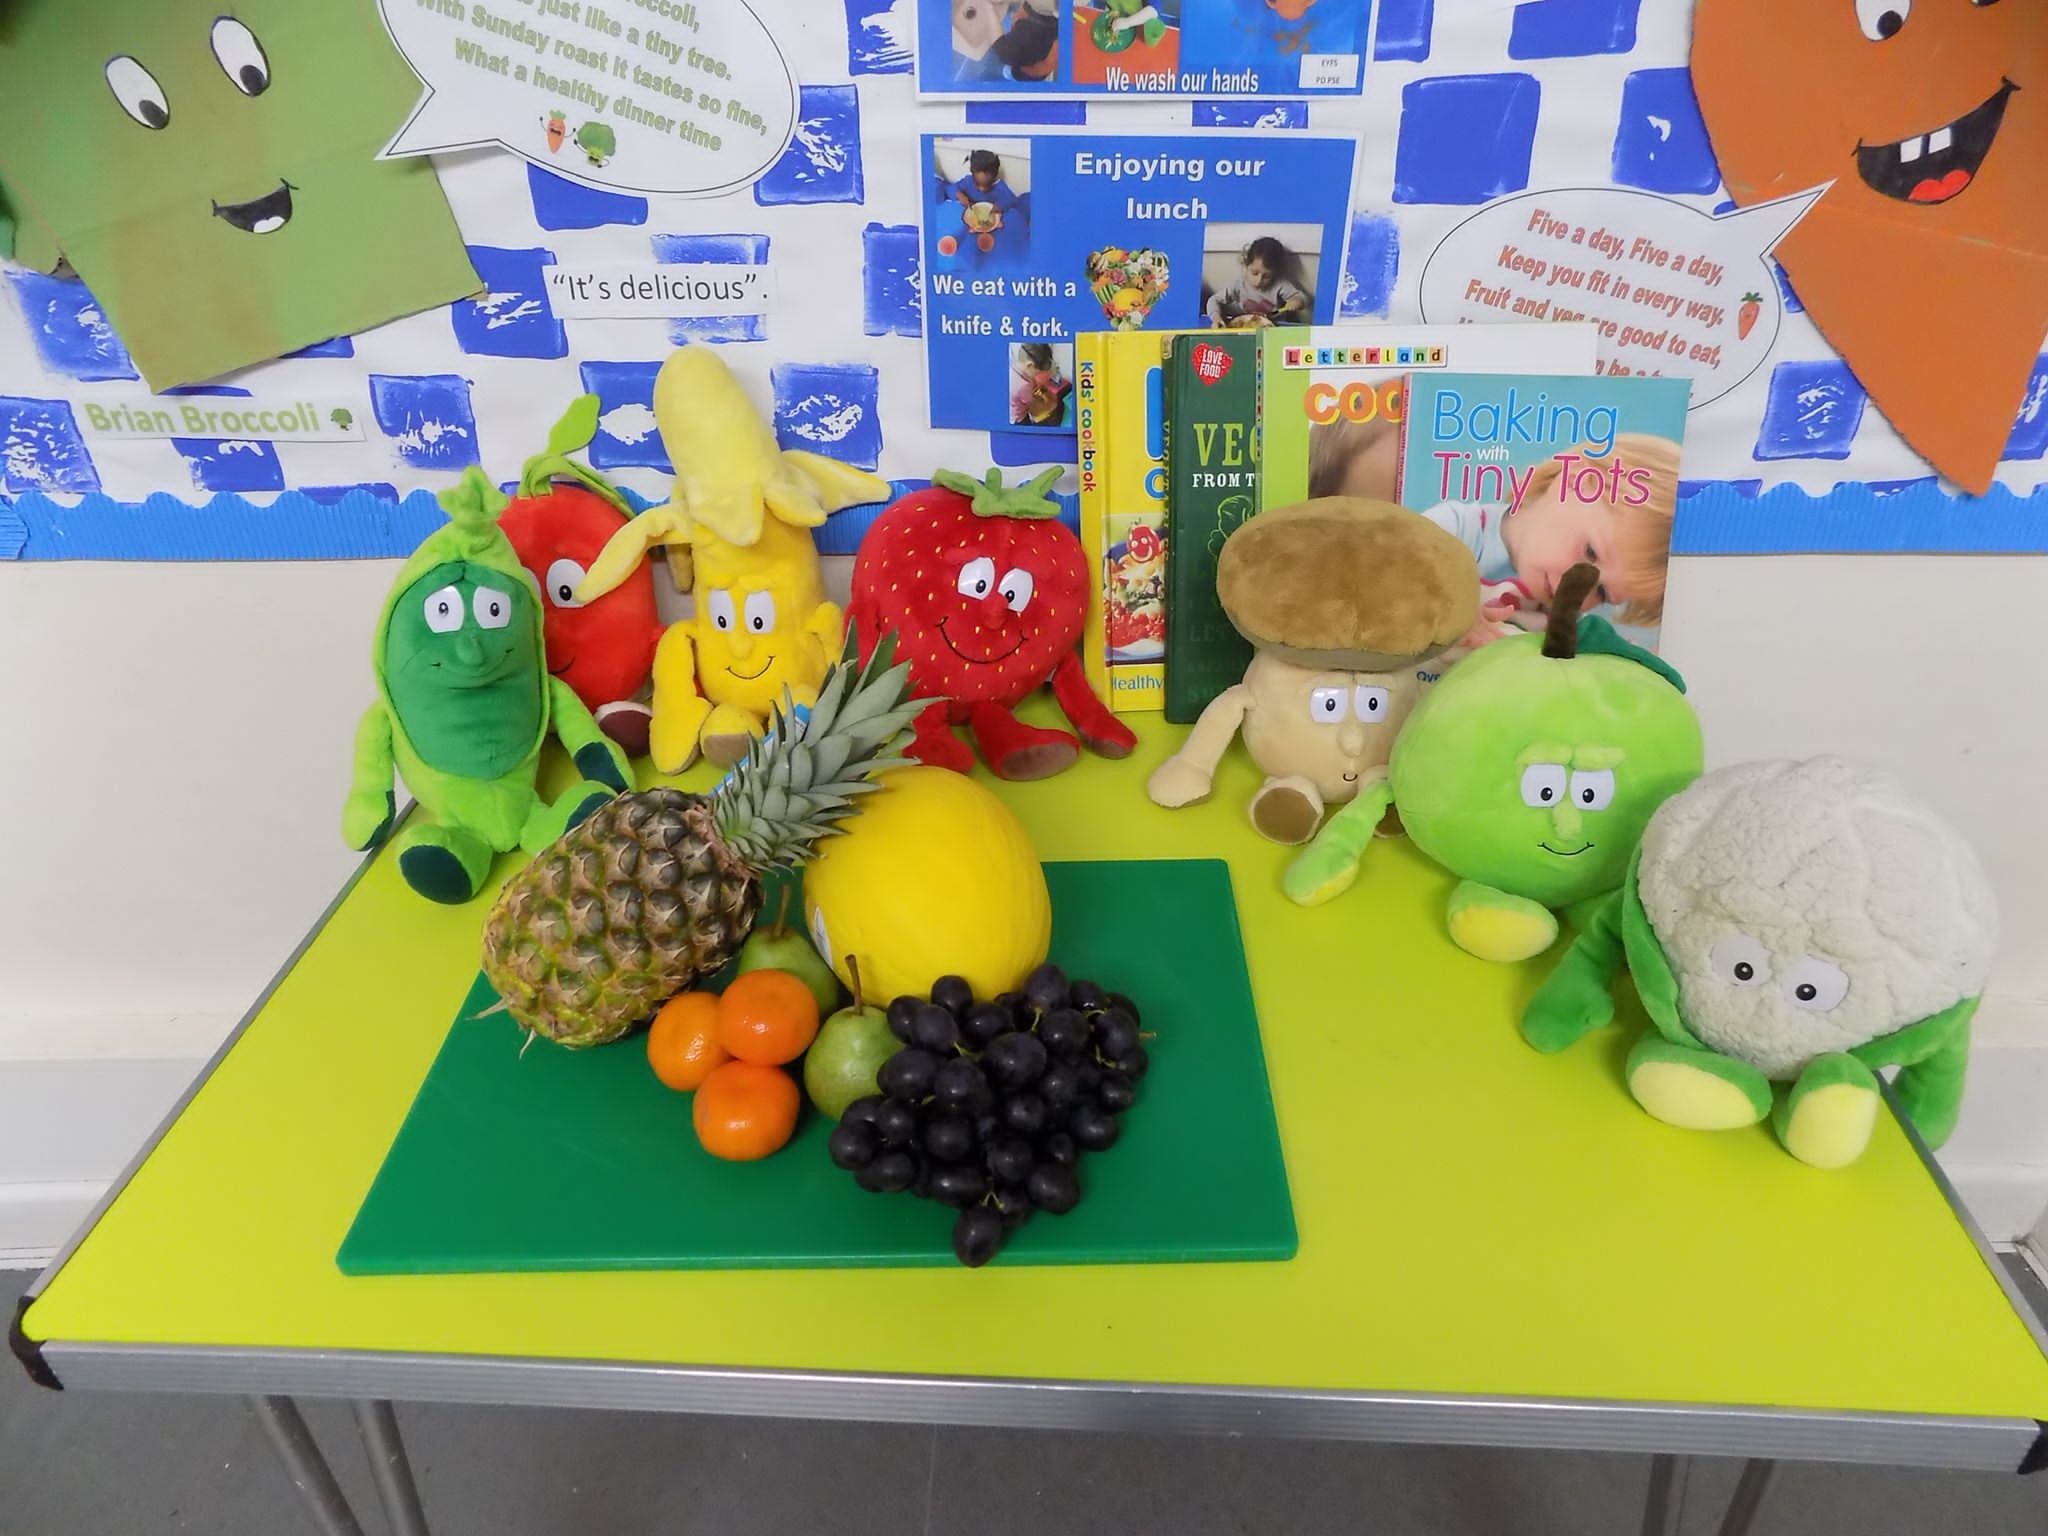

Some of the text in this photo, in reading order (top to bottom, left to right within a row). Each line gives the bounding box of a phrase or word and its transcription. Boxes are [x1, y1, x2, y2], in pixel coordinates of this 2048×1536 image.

[538, 0, 732, 81] just like a tiny tree.
[471, 4, 550, 54] Sunday
[554, 39, 609, 73] roast
[612, 55, 629, 80] it
[633, 64, 694, 103] tastes
[697, 93, 722, 114] so
[726, 99, 768, 136] fine,
[1106, 66, 1259, 93] We wash our hands
[455, 37, 722, 151] What a healthy dinner time
[1075, 152, 1266, 181] Enjoying our
[1127, 198, 1208, 219] lunch
[1527, 208, 1724, 288] Five a day, Five a day,
[932, 274, 1077, 298] We eat with a
[1497, 245, 1725, 330] Keep you fit in every way,
[941, 315, 1069, 337] knife & fork.
[1465, 279, 1511, 311] Fruit
[1512, 297, 1550, 320] and
[1591, 317, 1618, 338] re
[1619, 329, 1667, 350] good
[1667, 334, 1687, 356] to
[1688, 344, 1721, 370] eat,
[1199, 364, 1221, 378] FOOD
[1203, 349, 1223, 364] LOVE
[1289, 349, 1441, 364] Letterland
[84, 401, 321, 433] Brian Broccoli
[1433, 389, 1618, 456] Baking
[1082, 408, 1097, 492] cookbook
[1193, 423, 1256, 467] VE
[1476, 446, 1510, 461] with
[1192, 473, 1240, 488] FROM
[1433, 452, 1652, 516] Tiny Tots
